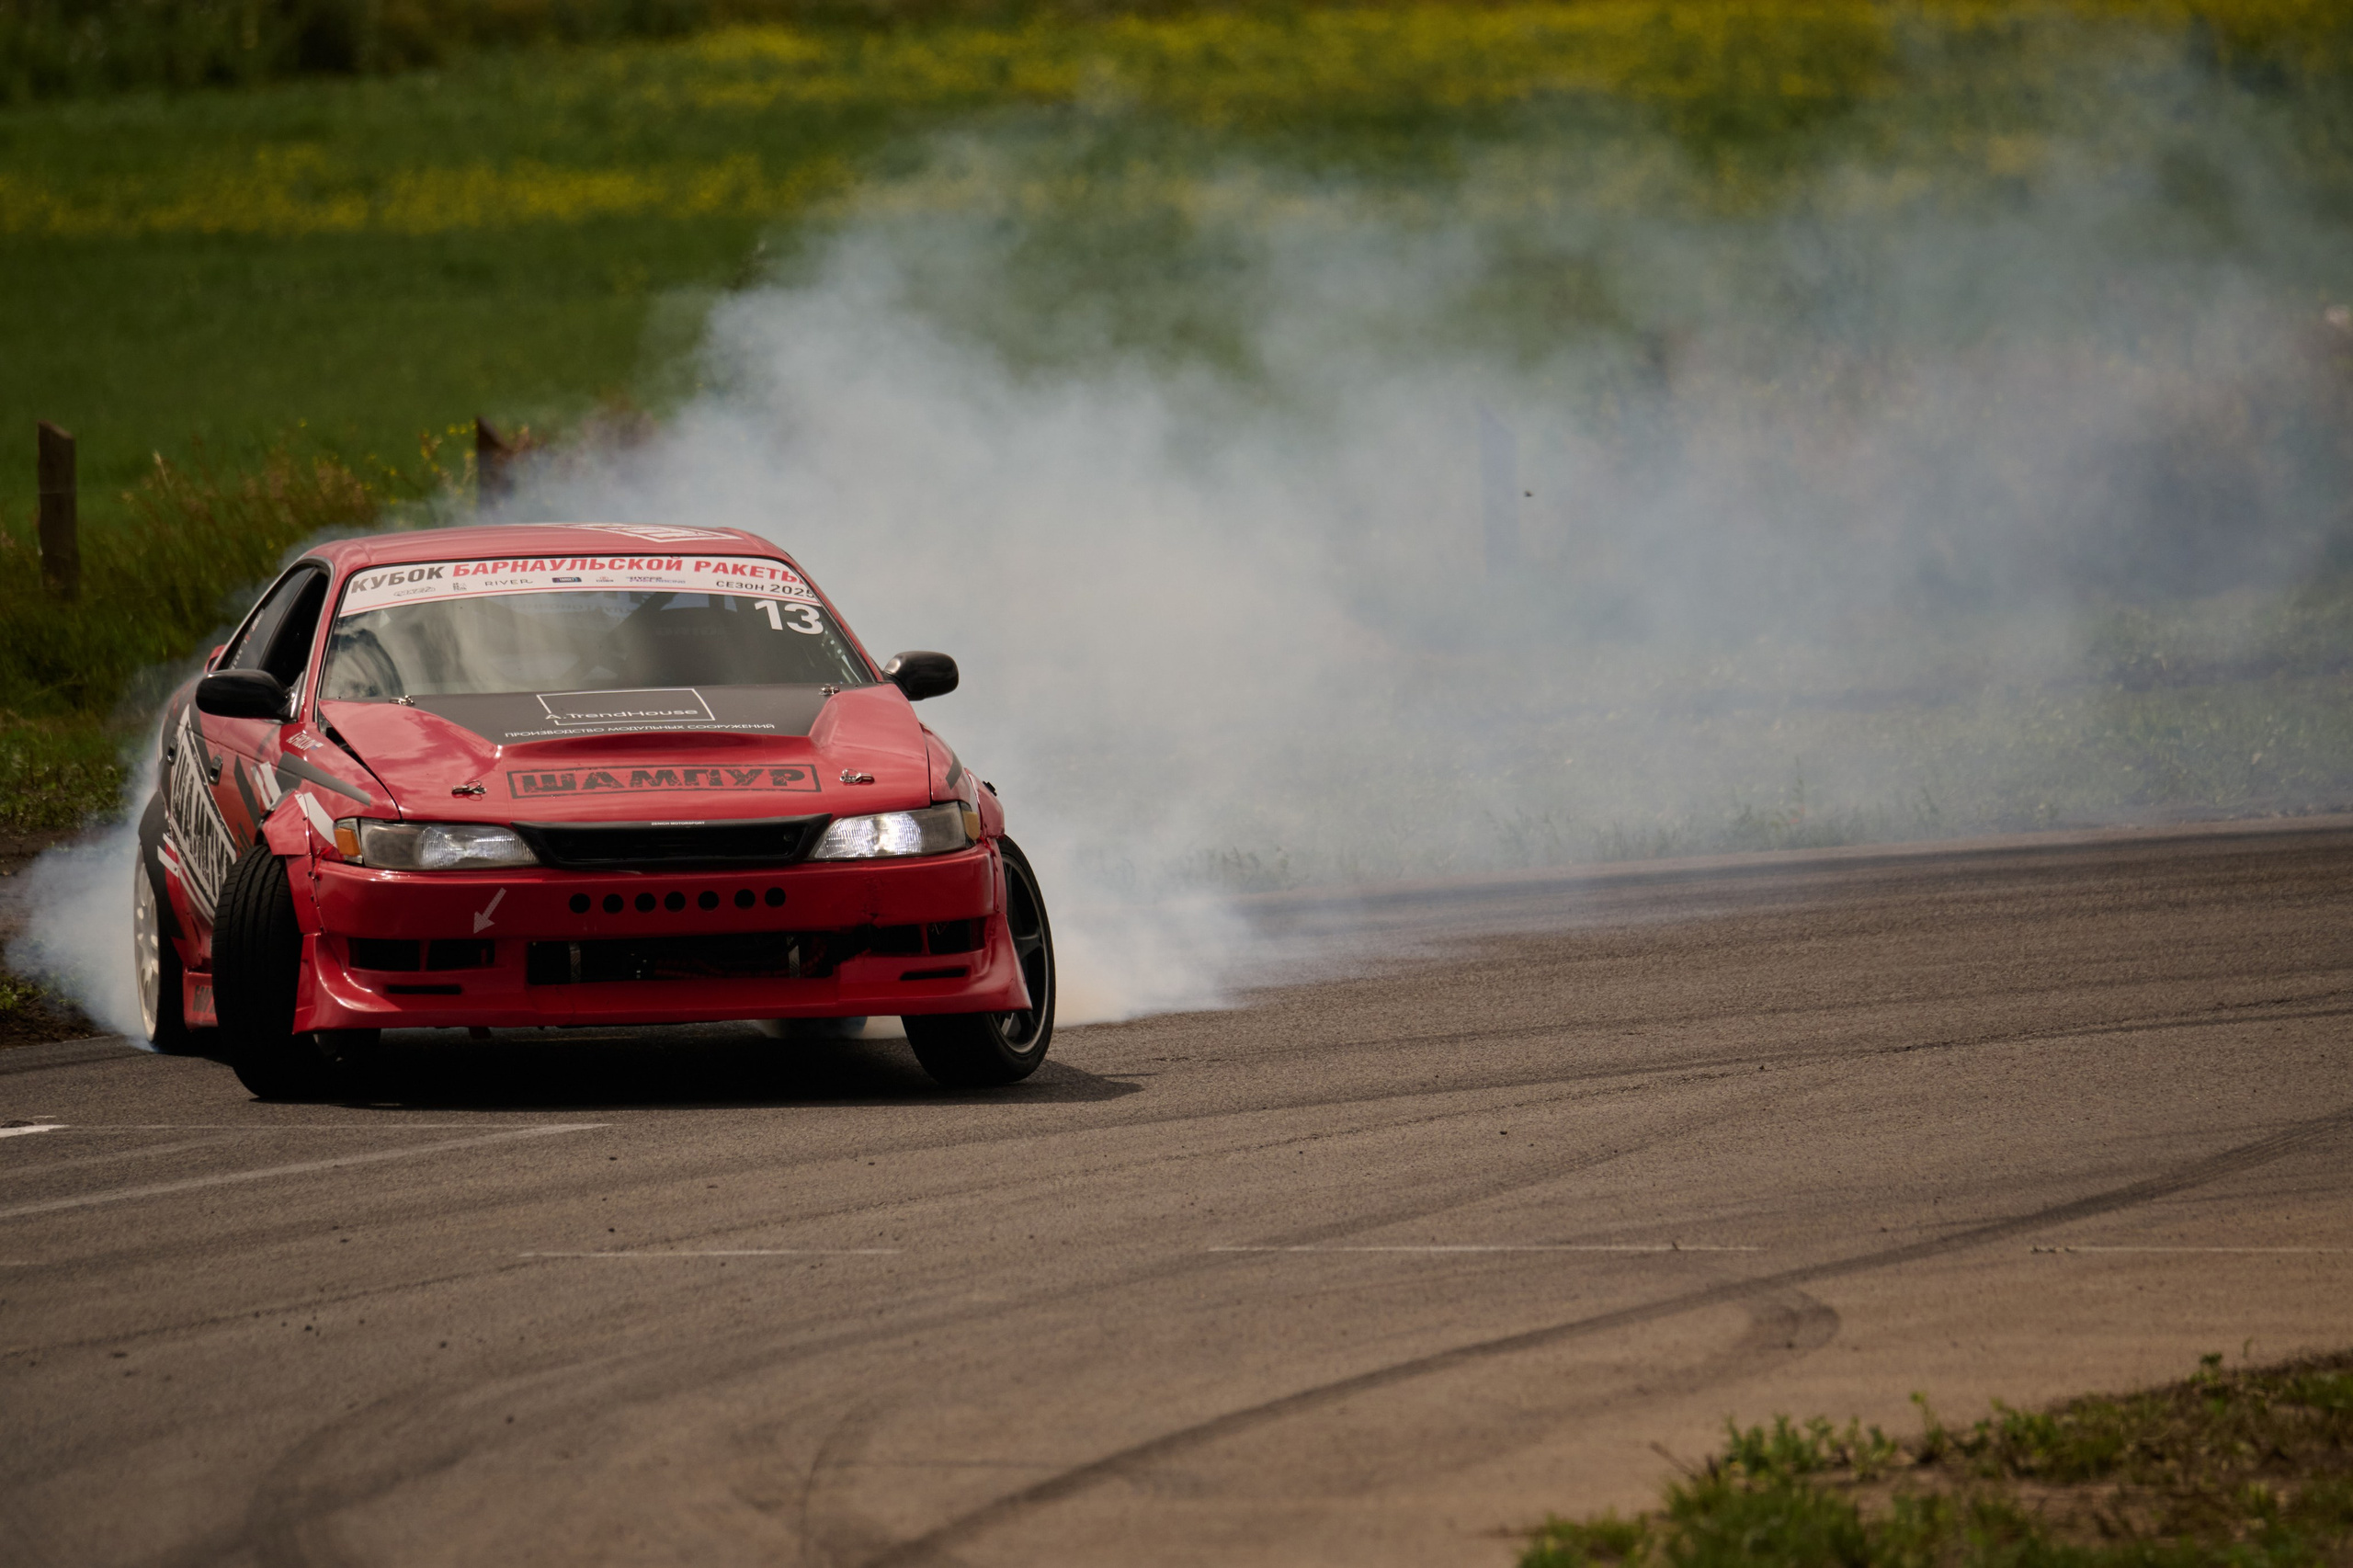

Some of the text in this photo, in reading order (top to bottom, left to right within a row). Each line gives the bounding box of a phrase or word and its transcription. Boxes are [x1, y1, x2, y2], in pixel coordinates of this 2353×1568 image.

[351, 566, 445, 594] КУБОК
[452, 557, 683, 577] БАРНАУЛЬСКОЙ
[484, 579, 533, 587] RIVER
[716, 580, 815, 598] СЕЗОН 2025
[755, 600, 824, 635] 13
[505, 727, 605, 738] ПРОИЗВОДСТВО
[608, 724, 685, 733] МОДУЛЬНЫХ
[521, 768, 806, 792] ШАМПУР
